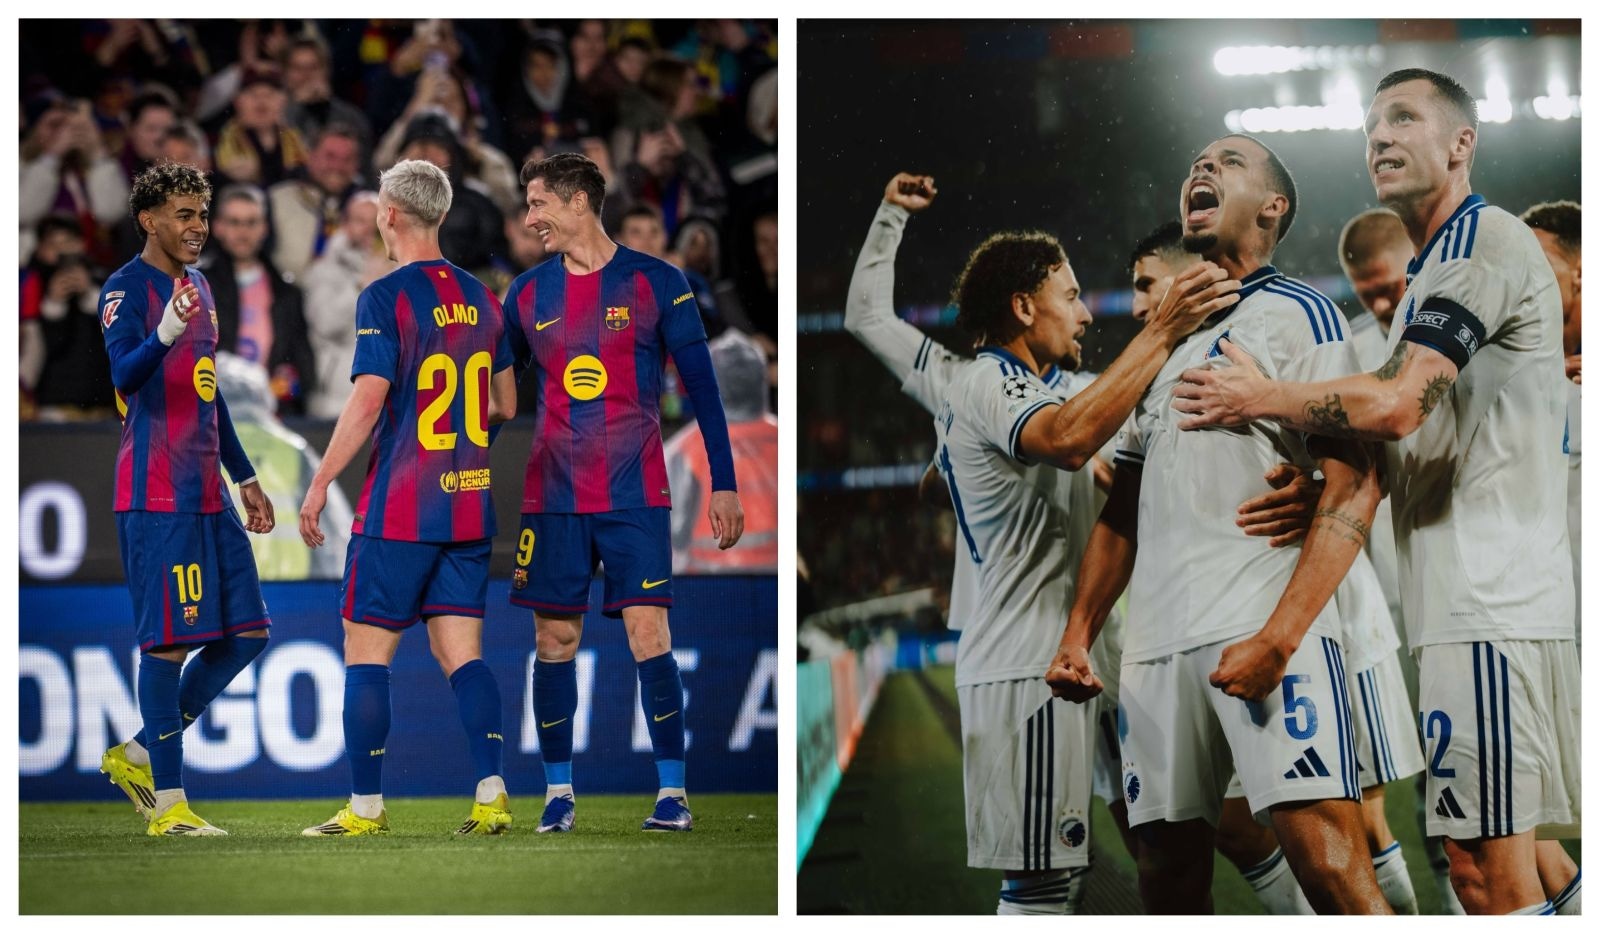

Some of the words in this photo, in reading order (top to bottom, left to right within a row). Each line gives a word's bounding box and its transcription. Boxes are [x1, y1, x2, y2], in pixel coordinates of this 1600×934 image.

[433, 304, 478, 327] OLMO
[1411, 314, 1448, 325] ESPECT
[417, 351, 492, 450] 20
[459, 468, 490, 480] UNHCR
[460, 477, 490, 488] ACNUR
[516, 528, 536, 567] 9
[172, 563, 203, 604] 10
[1281, 674, 1319, 740] 5
